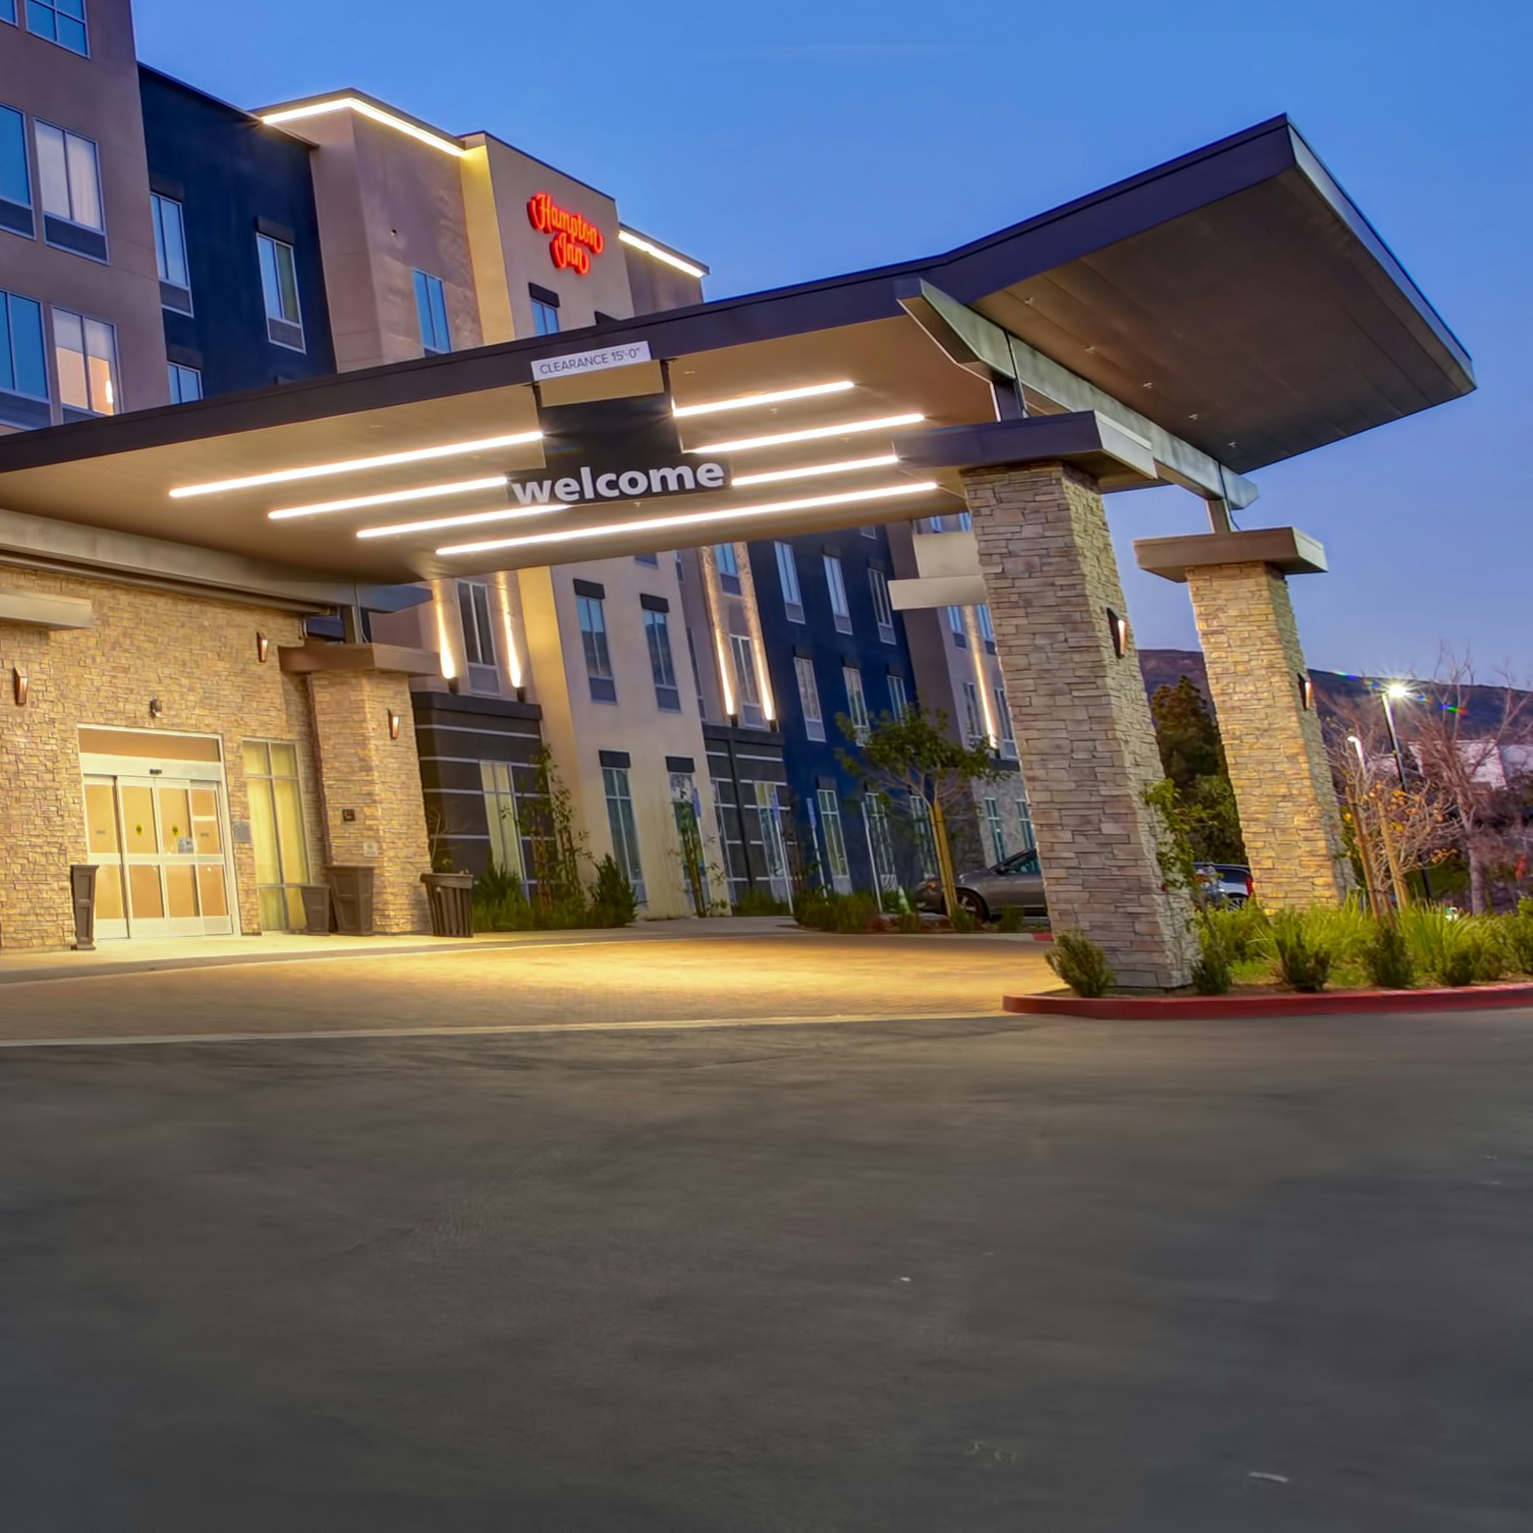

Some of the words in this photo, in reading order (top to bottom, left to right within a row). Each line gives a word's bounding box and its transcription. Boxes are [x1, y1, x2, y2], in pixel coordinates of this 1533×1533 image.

[527, 192, 604, 254] Hampton
[550, 232, 590, 274] Inn
[539, 353, 609, 375] CLEARANCE
[511, 462, 725, 505] welcome
